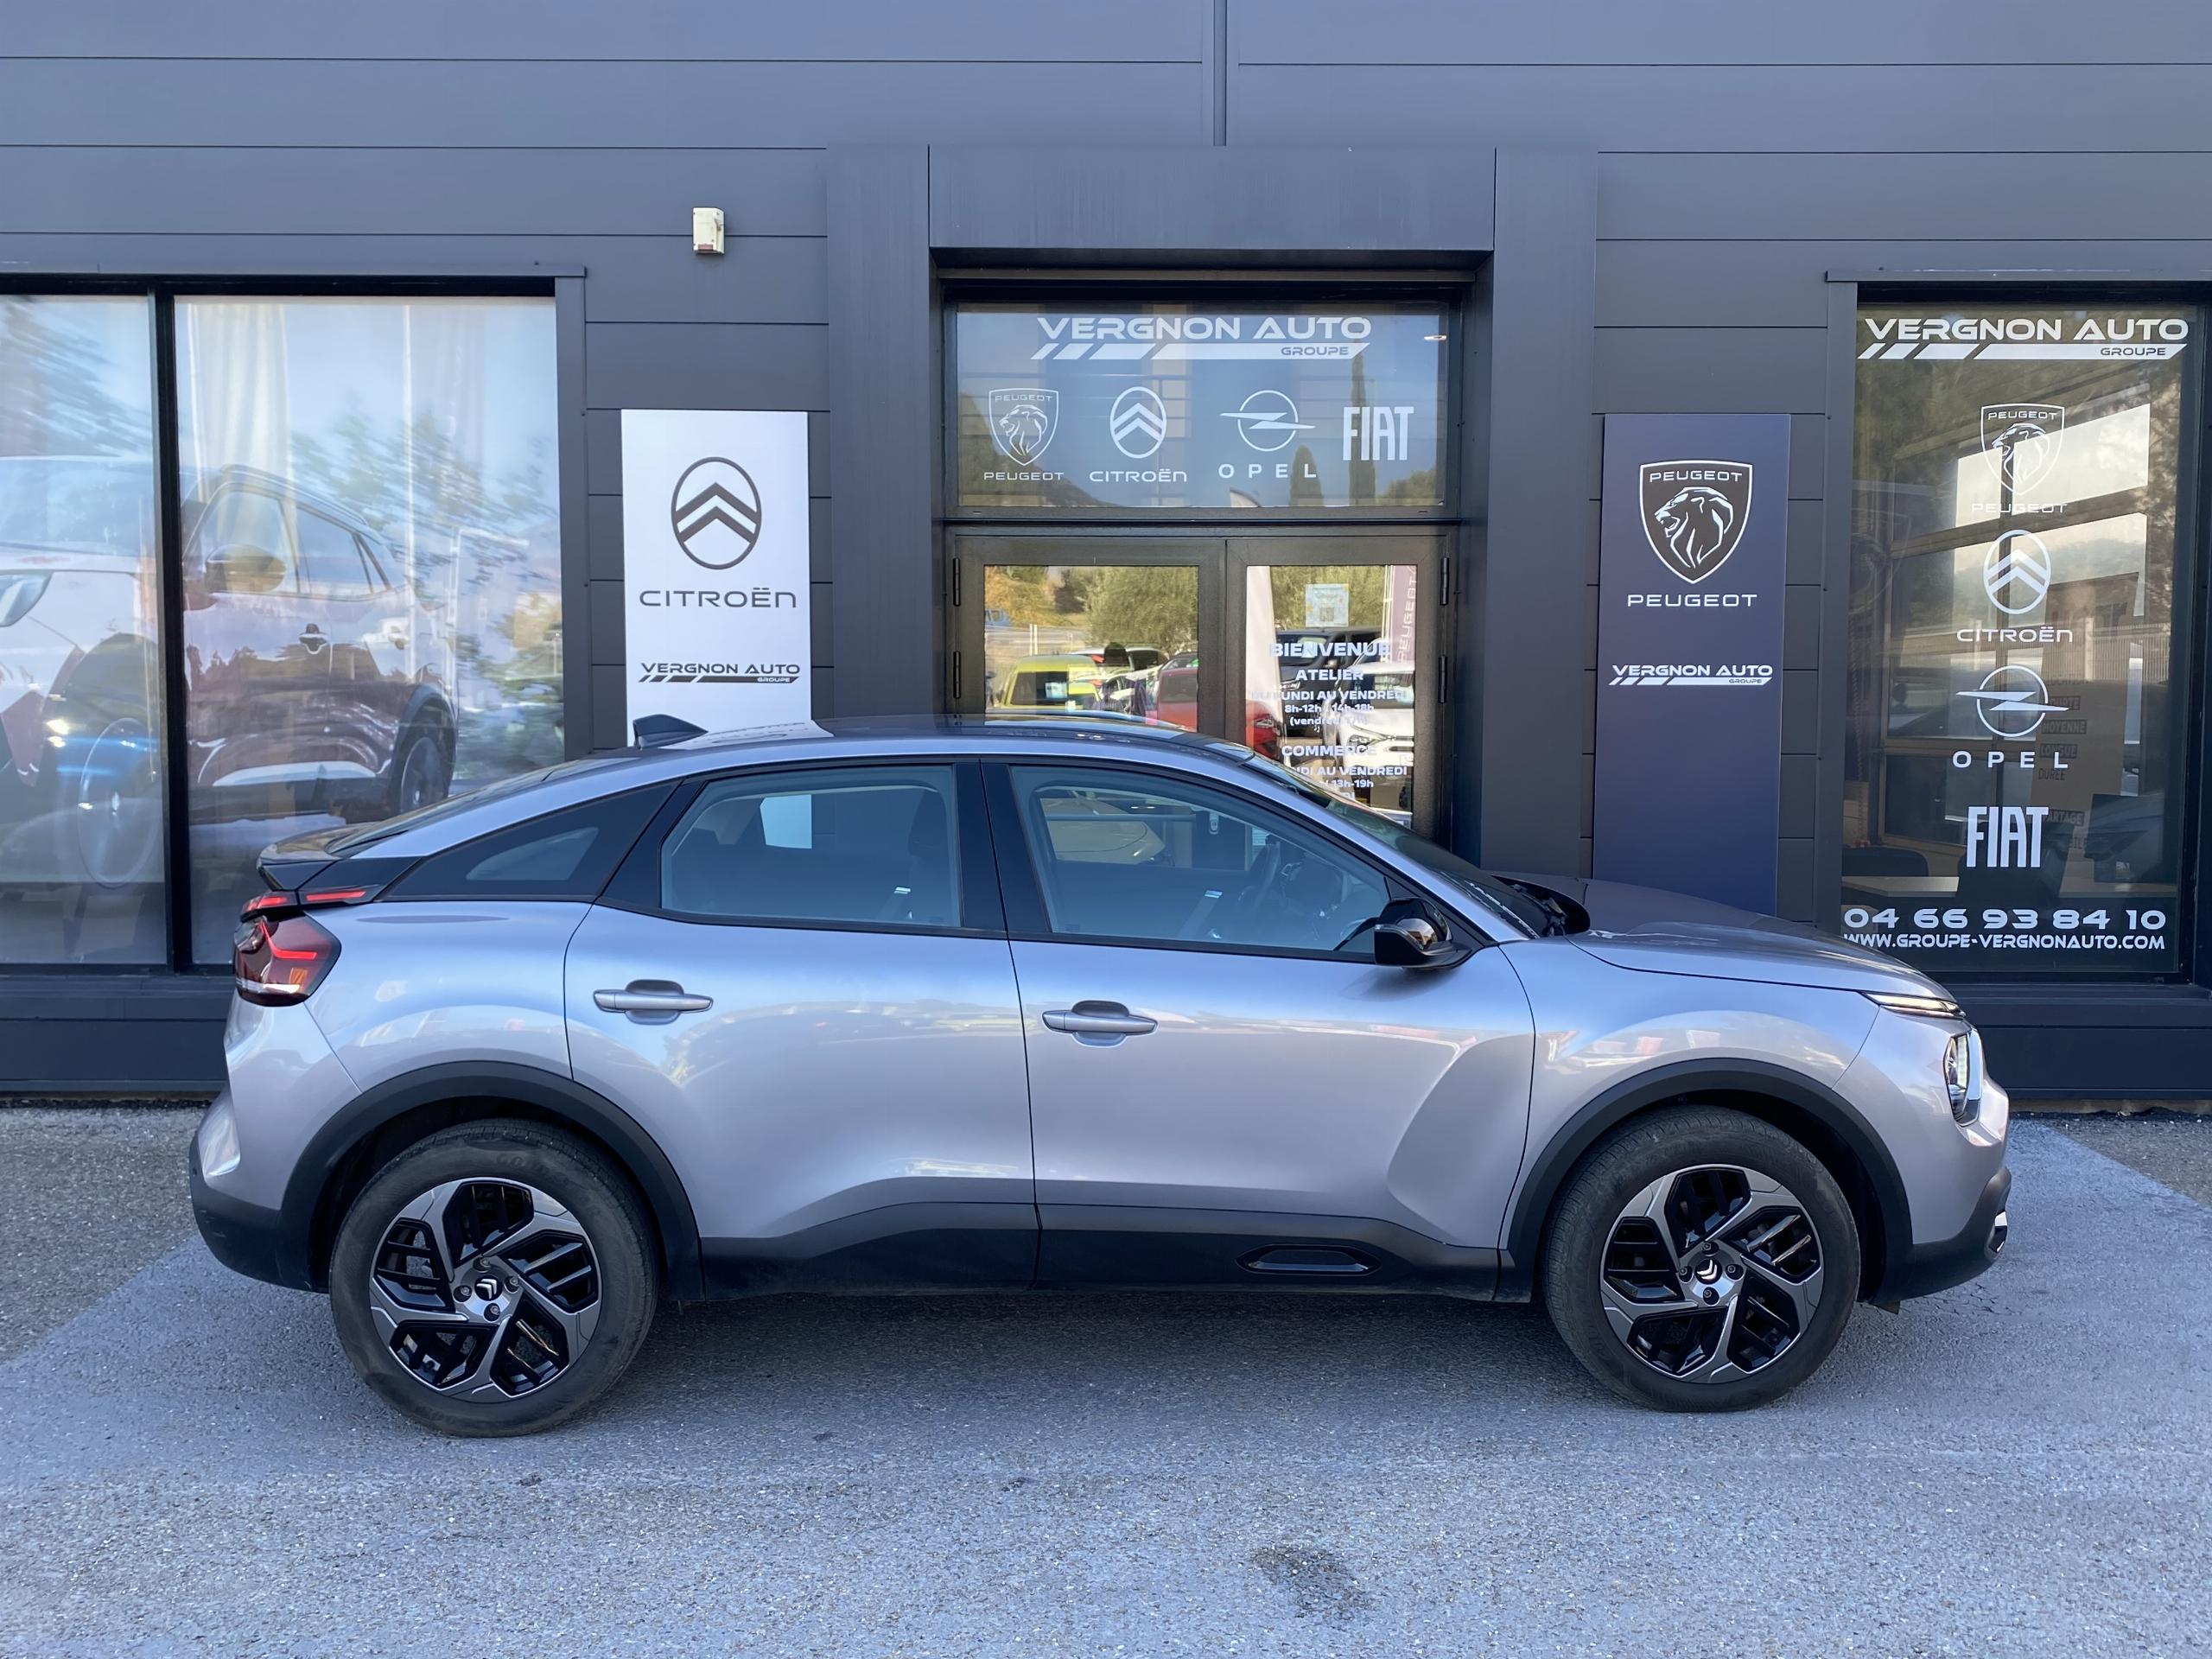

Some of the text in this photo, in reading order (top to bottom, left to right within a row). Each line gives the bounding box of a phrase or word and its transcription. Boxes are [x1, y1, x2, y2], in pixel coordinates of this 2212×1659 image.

[1038, 317, 1371, 340] VERGNON AUTO
[1865, 318, 2189, 340] VERGNON AUTO
[1281, 346, 1350, 356] GROUPE
[2101, 347, 2166, 356] GROUPE
[995, 393, 1053, 404] PEUGEOT
[1987, 410, 2057, 421] PEUGEOT
[1343, 406, 1414, 461] FIAT
[983, 472, 1065, 481] PEUGEOT
[1218, 463, 1317, 479] OPEL
[1649, 470, 1743, 483] PEUGEOT
[1971, 503, 2068, 514] PEUGEOT
[1628, 594, 1758, 607] PEUGEOT
[1269, 642, 1390, 657] BIENVENUE
[640, 663, 800, 675] VERGNON AUTO
[1296, 669, 1363, 681] ATELIER
[1612, 664, 1773, 677] VERGNON AUTO
[1316, 690, 1337, 700] AU
[1284, 703, 1322, 713] 8h-12h
[1281, 746, 1377, 756] COMMERCE
[1953, 751, 2068, 769] OPEL
[1316, 766, 1336, 776] AU
[1339, 766, 1408, 776] VENDREDI
[1967, 807, 2049, 868] FIAT
[1844, 908, 2166, 930] 04 66 93 84 10
